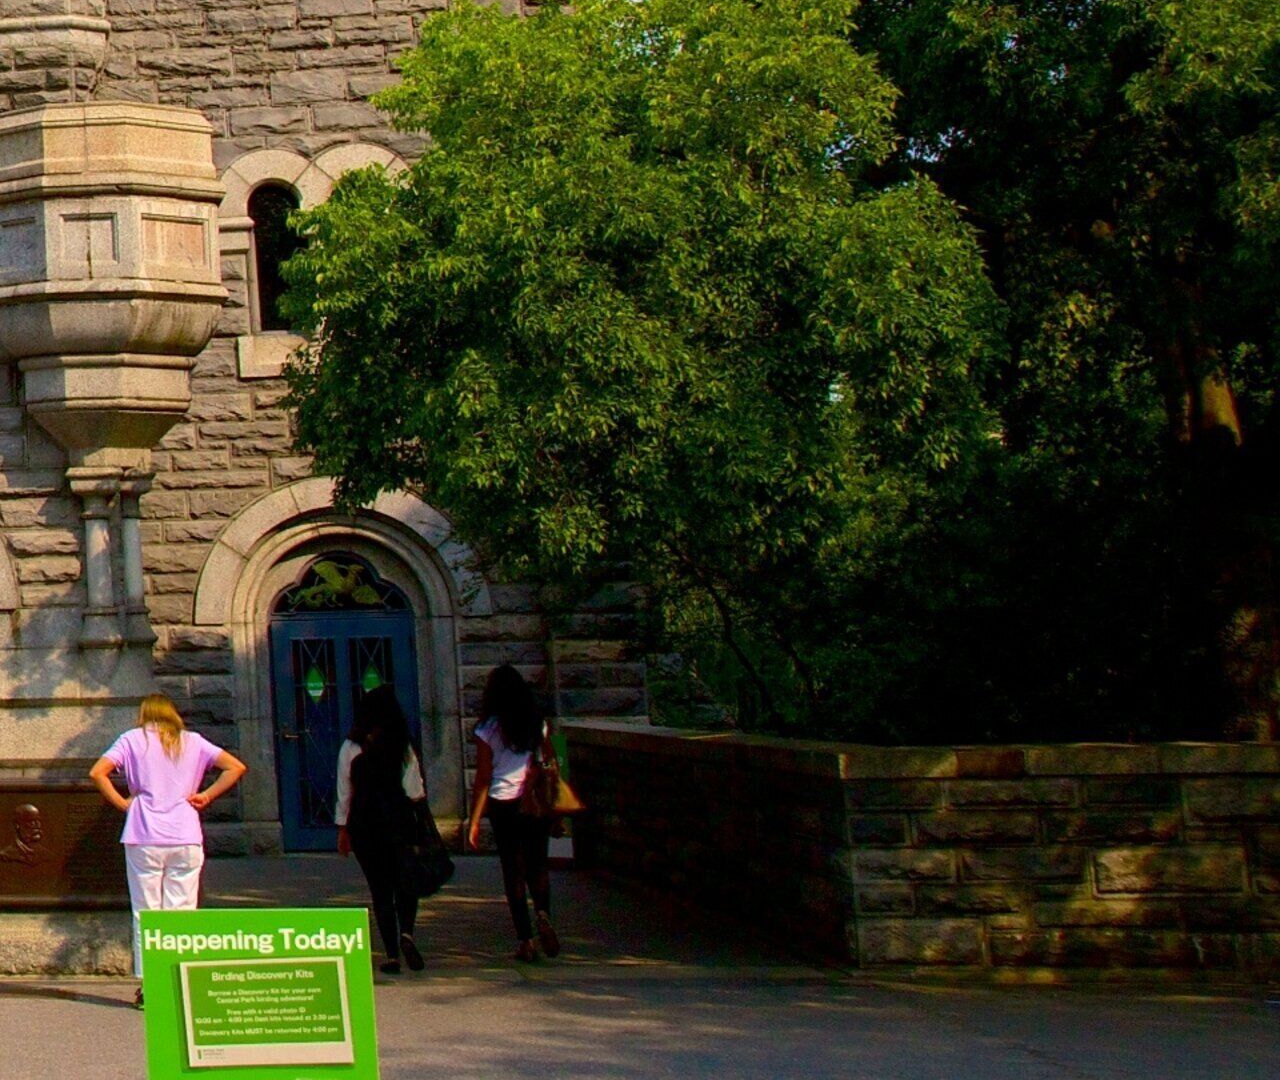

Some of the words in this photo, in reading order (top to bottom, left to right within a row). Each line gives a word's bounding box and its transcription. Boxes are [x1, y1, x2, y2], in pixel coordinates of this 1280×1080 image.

[144, 928, 273, 954] Happening
[278, 927, 364, 954] Today!
[211, 971, 245, 982] Birding
[247, 970, 293, 981] Discovery
[295, 969, 314, 978] Kits
